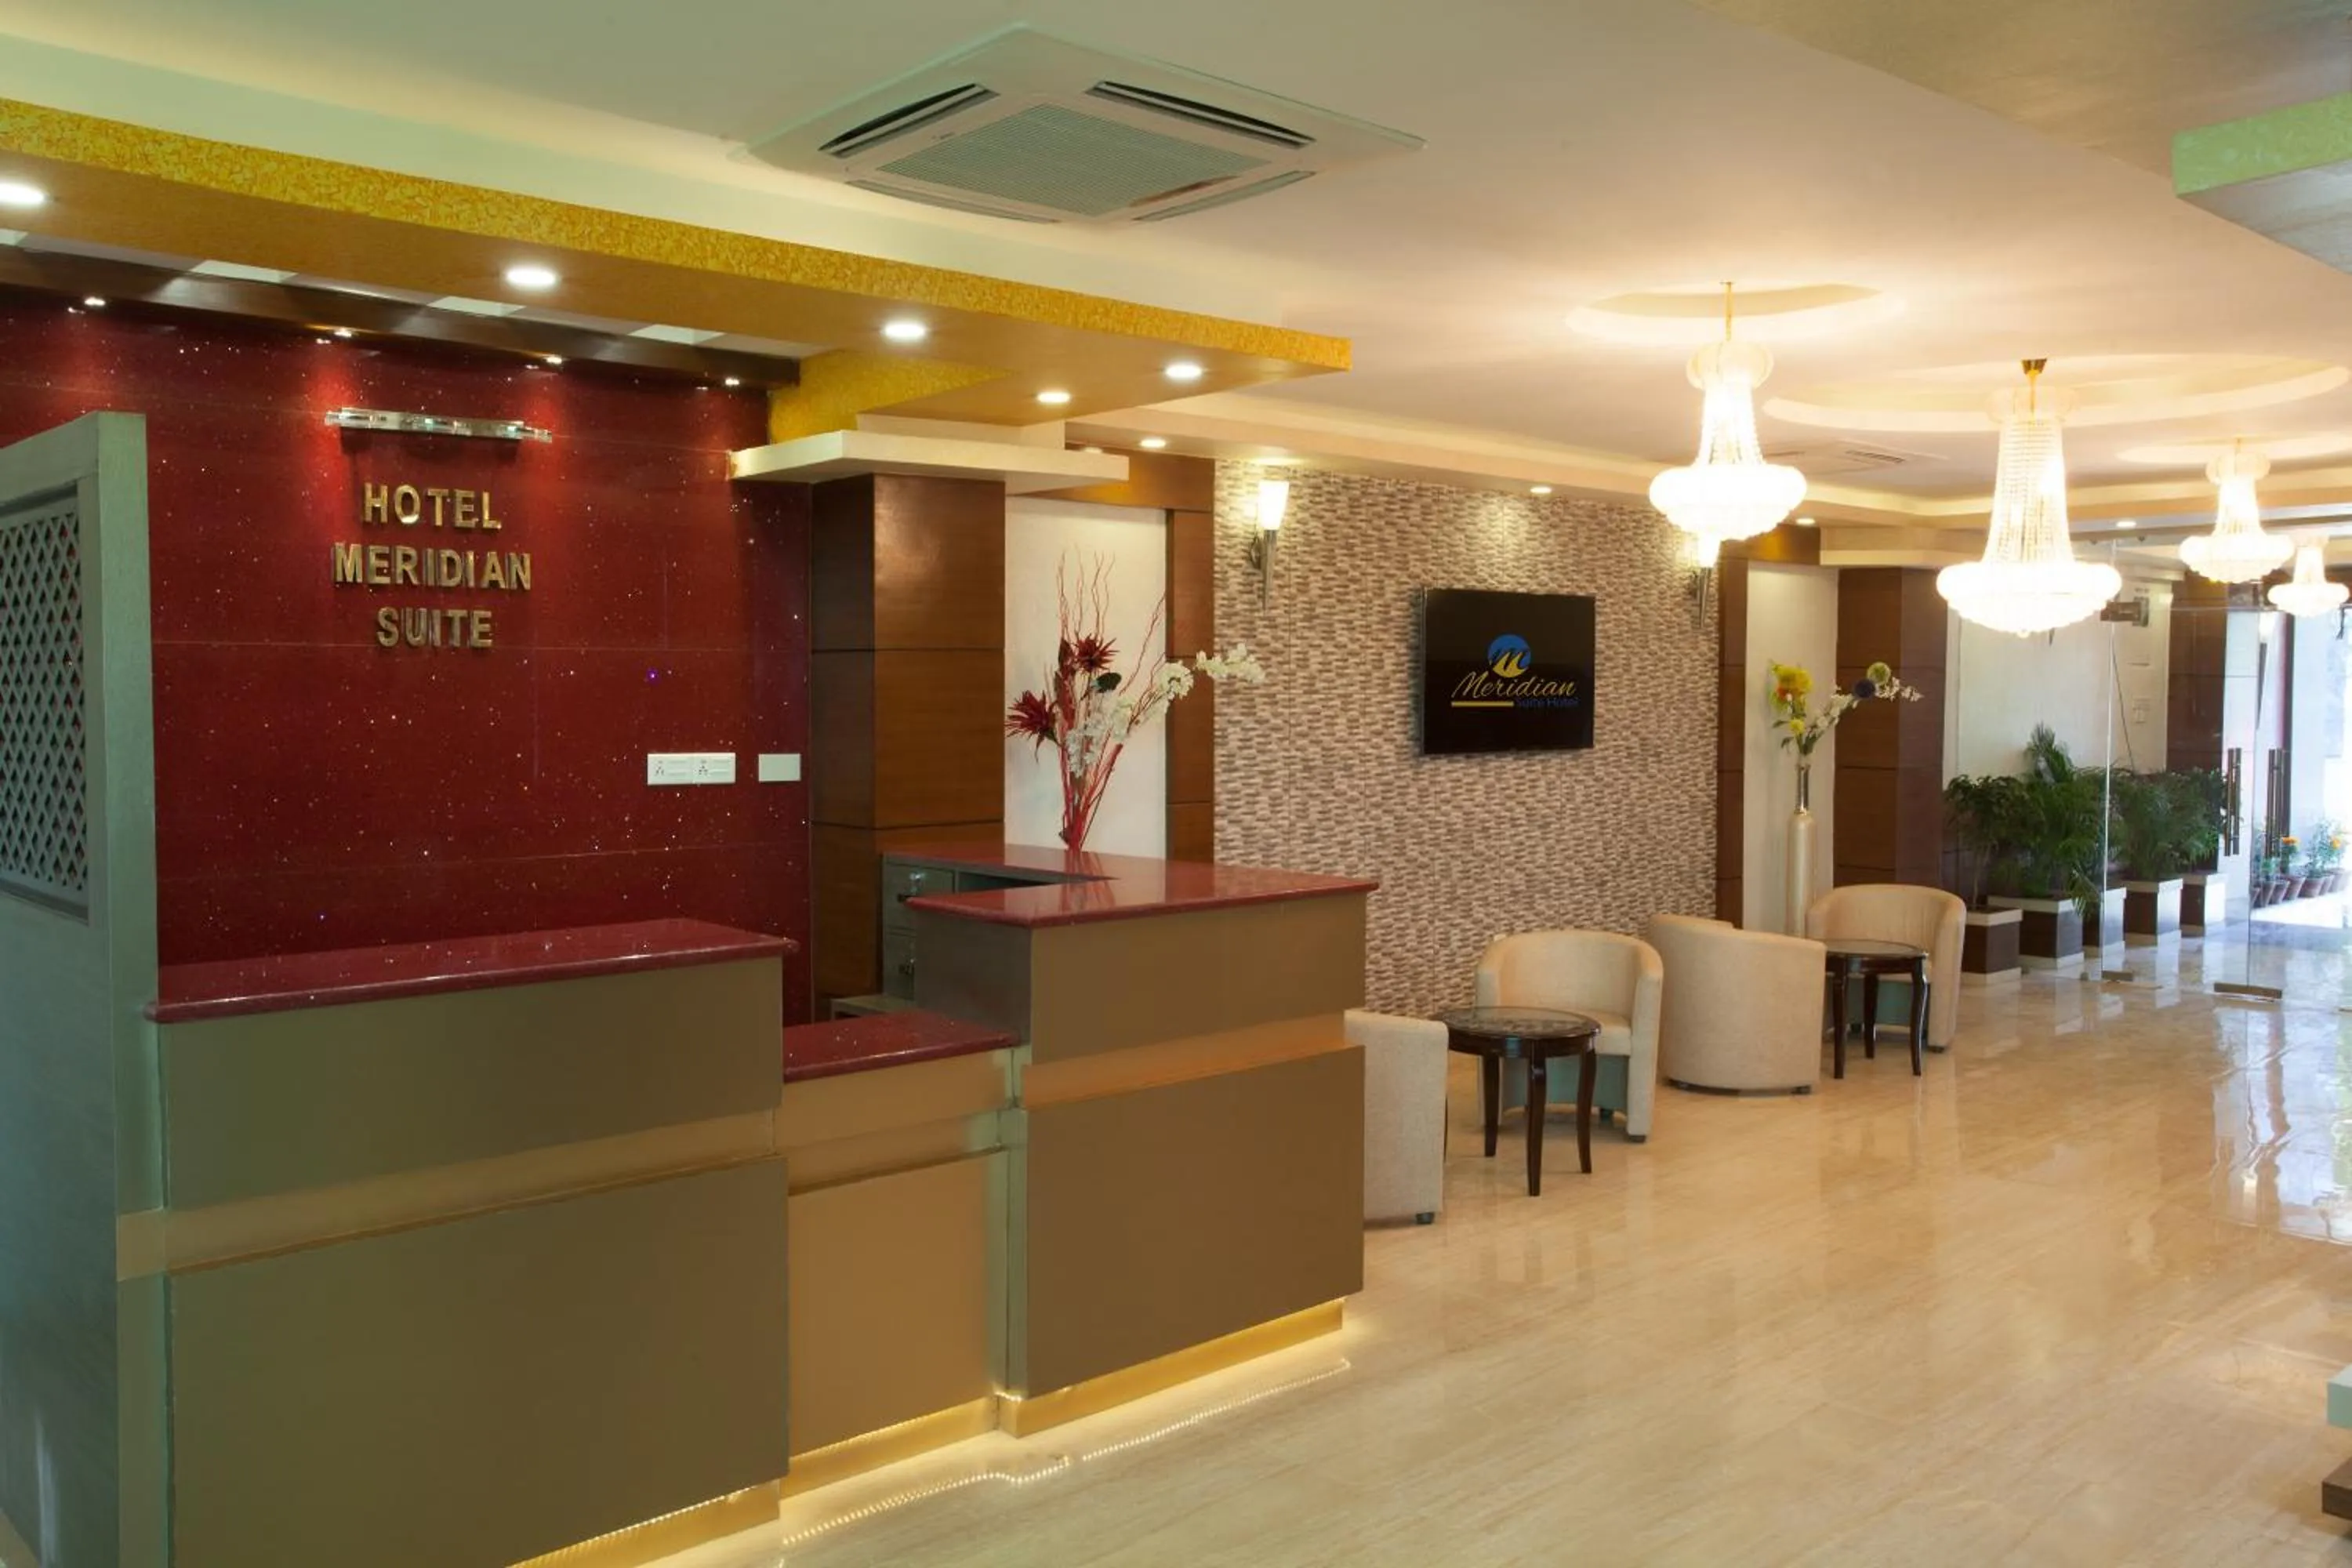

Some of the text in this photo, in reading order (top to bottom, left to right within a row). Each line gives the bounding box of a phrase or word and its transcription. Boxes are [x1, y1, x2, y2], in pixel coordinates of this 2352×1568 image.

[363, 482, 502, 530] HOTEL
[332, 542, 532, 590] MERIDIAN
[376, 606, 493, 649] SUITE
[1451, 670, 1576, 699] Meridian
